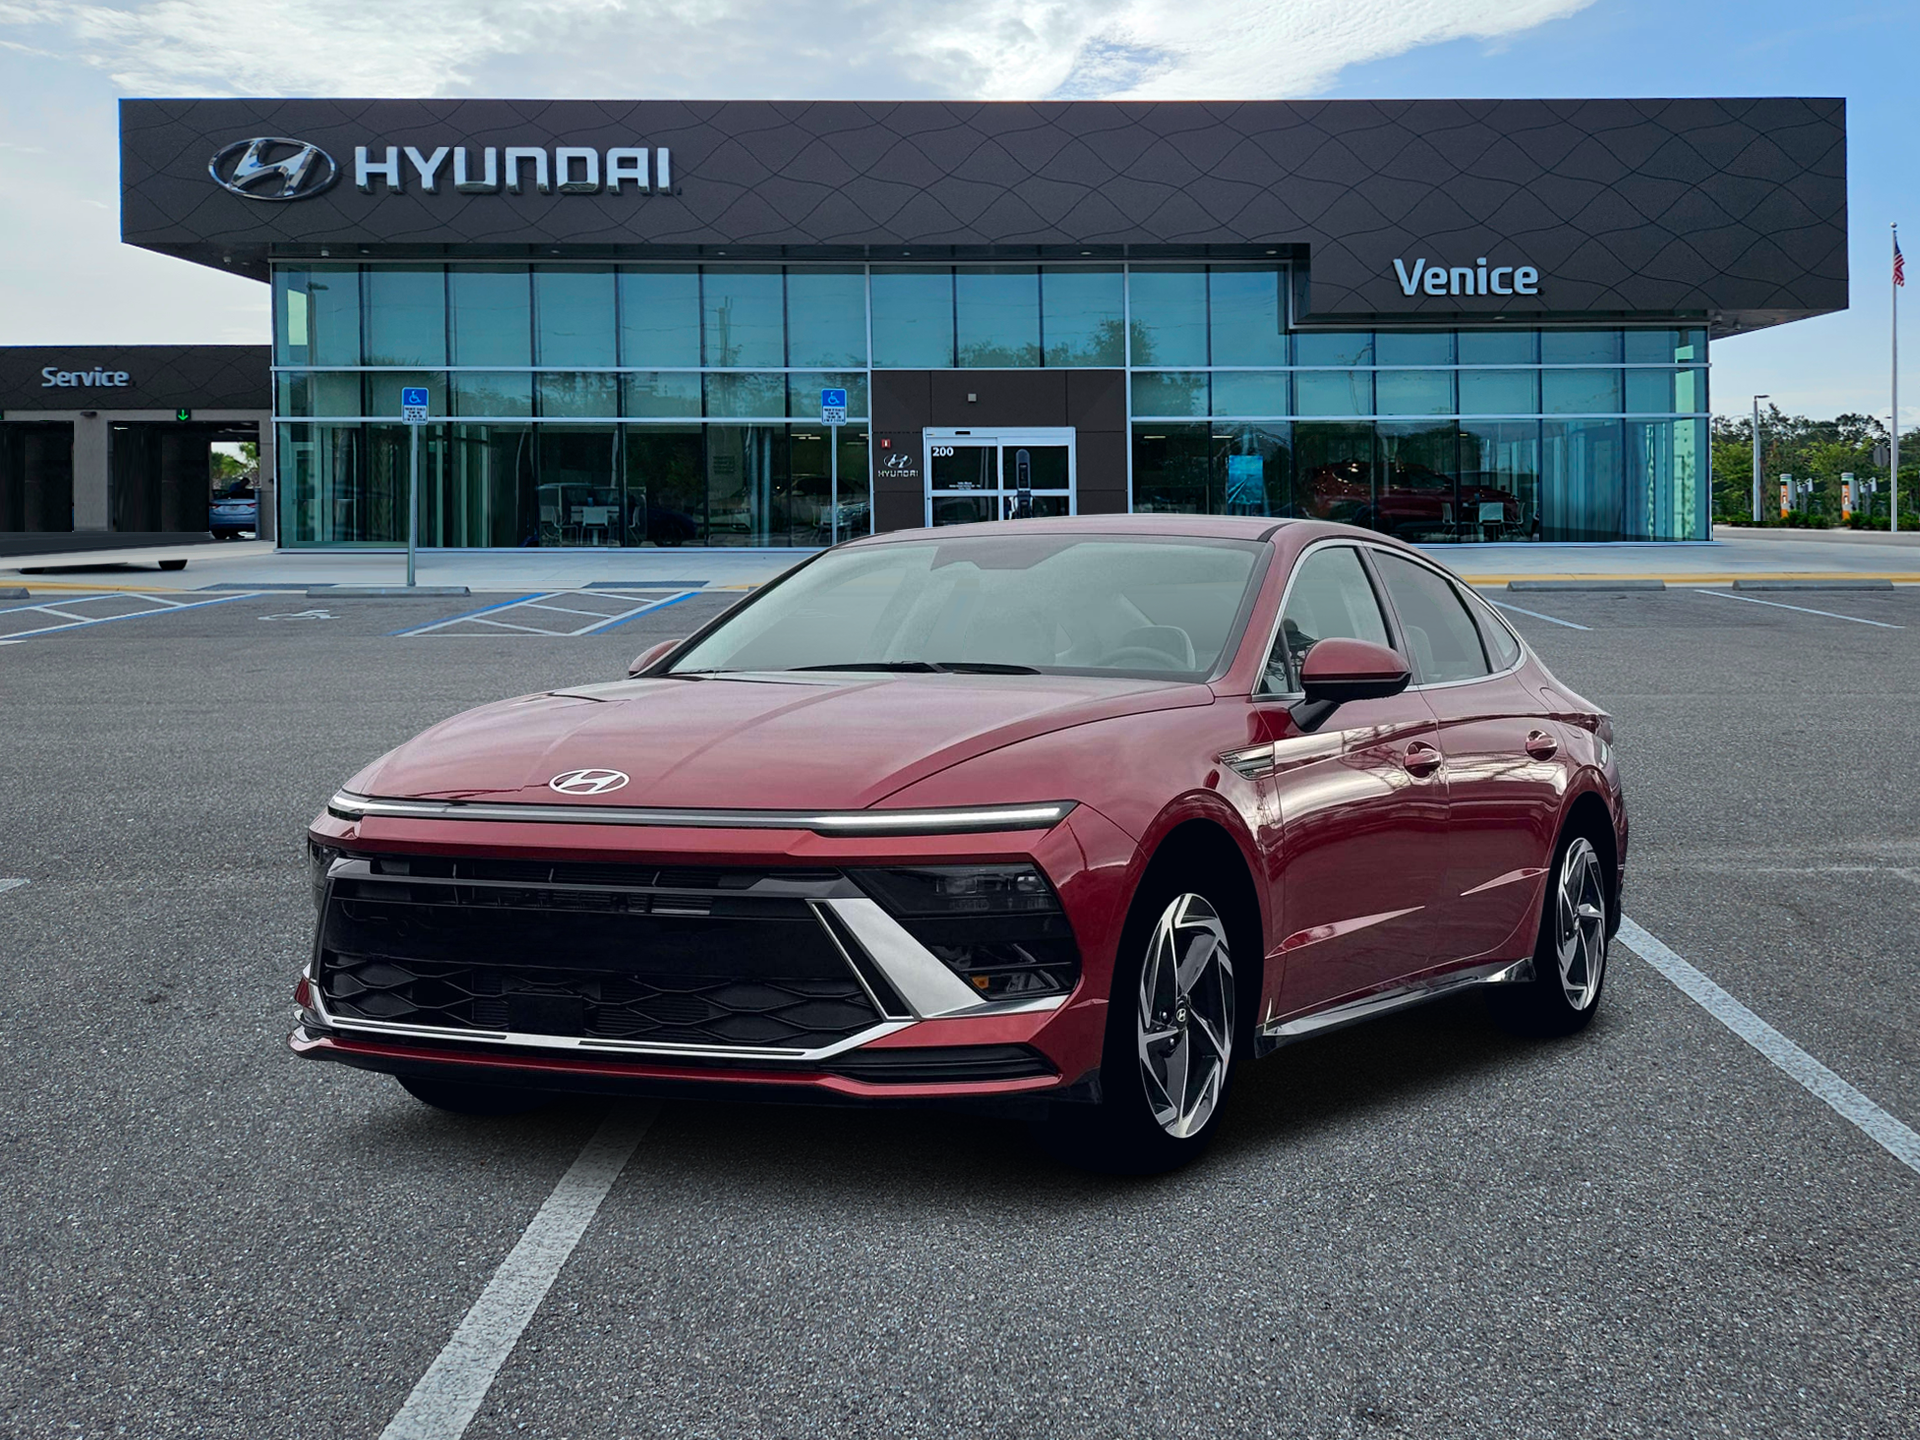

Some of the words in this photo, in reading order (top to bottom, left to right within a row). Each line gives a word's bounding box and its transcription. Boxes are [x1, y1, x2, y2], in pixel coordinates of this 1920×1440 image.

[355, 147, 670, 193] HYUNDAI
[1393, 257, 1538, 296] Venice
[41, 366, 130, 387] Service
[932, 447, 954, 457] 200
